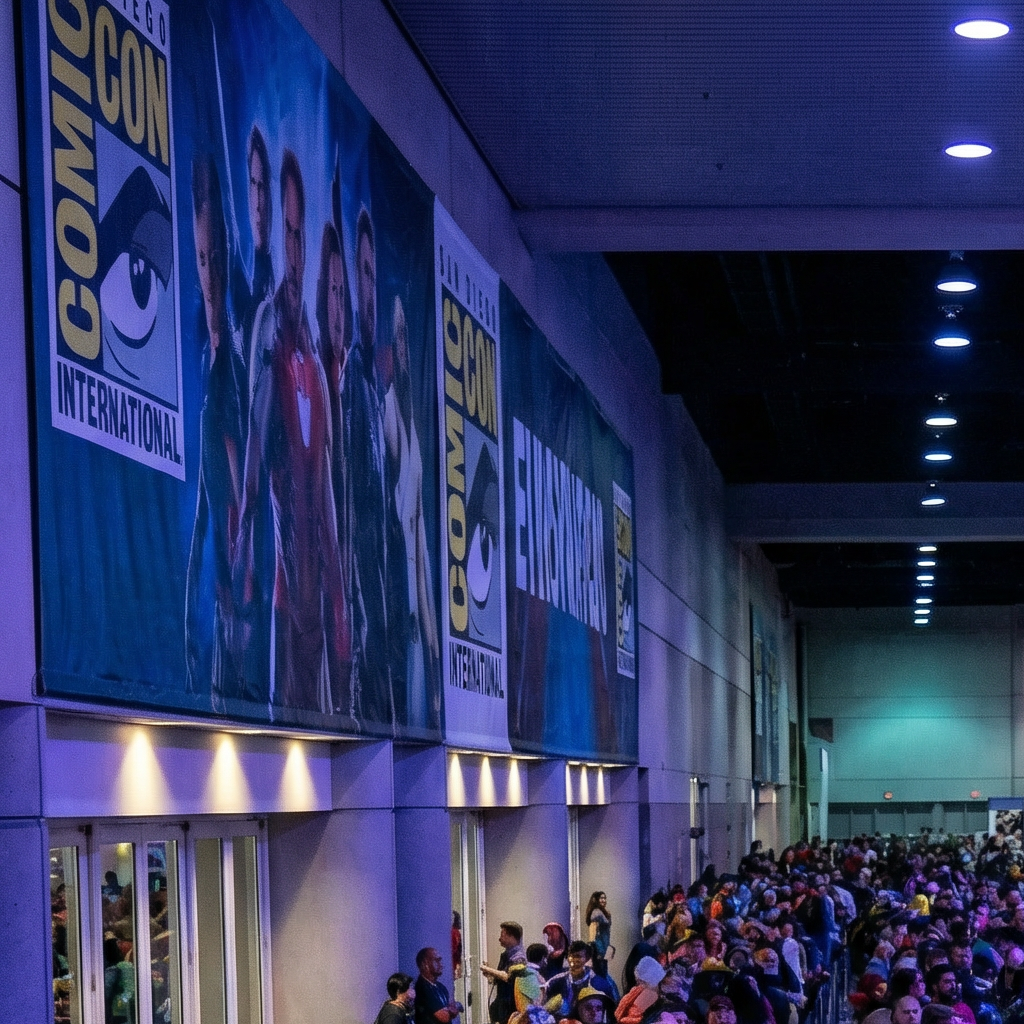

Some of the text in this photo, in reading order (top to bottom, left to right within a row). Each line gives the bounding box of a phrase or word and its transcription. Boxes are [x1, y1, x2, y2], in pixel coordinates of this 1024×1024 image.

[94, 5, 170, 166] CON
[57, 361, 183, 465] INTERNATIONAL
[463, 314, 498, 439] CON
[443, 297, 470, 634] COMIC
